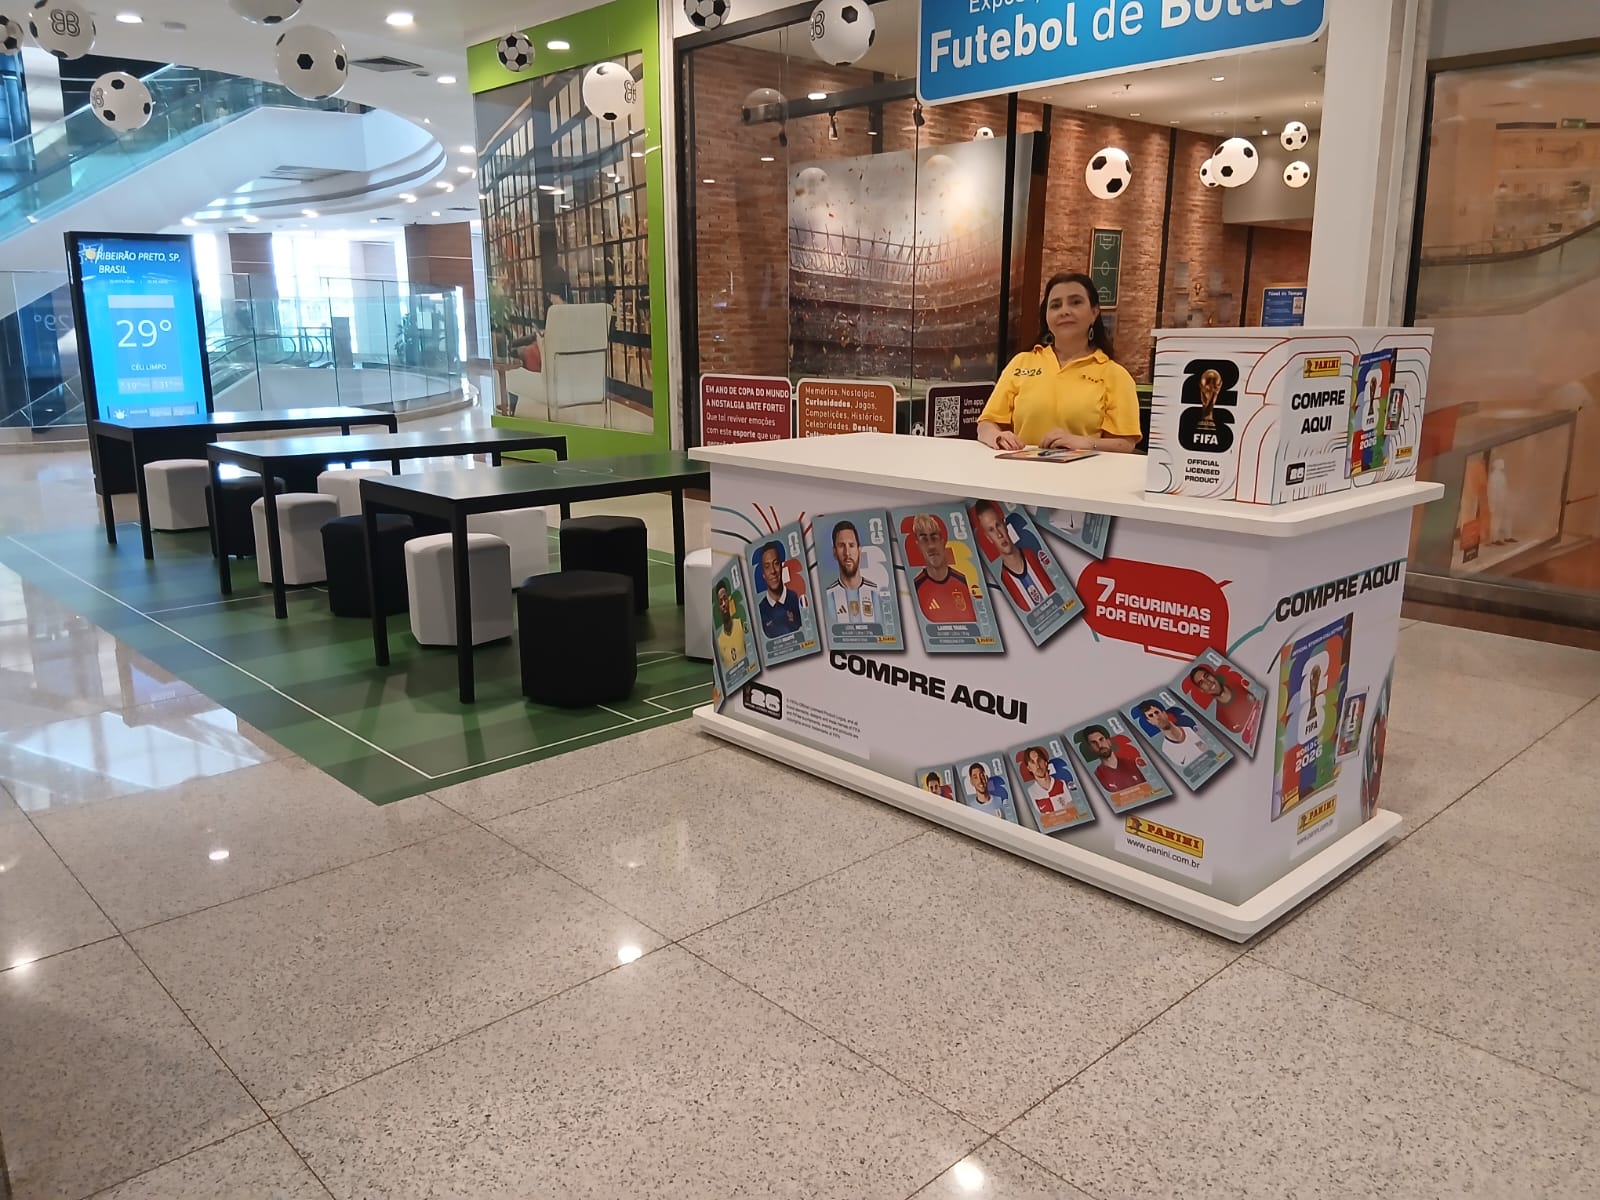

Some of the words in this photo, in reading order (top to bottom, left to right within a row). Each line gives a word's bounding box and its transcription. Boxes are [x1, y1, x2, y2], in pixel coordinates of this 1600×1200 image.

[930, 2, 1078, 72] Futebol
[1092, 0, 1144, 41] de
[97, 250, 137, 261] RIBEIRÃO
[98, 265, 127, 274] BRASIL
[116, 319, 172, 348] 29°
[1314, 359, 1339, 370] PANINI
[706, 385, 715, 393] EM
[716, 386, 728, 394] ANO
[729, 386, 738, 395] DE
[738, 387, 754, 396] COPA
[755, 388, 765, 397] DO
[766, 389, 789, 399] MUNDO
[1291, 389, 1346, 411] COMPRE
[711, 399, 745, 409] NOSTALGIA
[746, 401, 762, 411] BATE
[763, 403, 785, 413] FORTE!
[706, 412, 717, 421] Que
[718, 413, 726, 421] tal
[727, 415, 748, 423] reviver
[749, 417, 776, 427] emoções
[1301, 415, 1332, 435] AQUI
[707, 427, 719, 435] com
[720, 428, 732, 436] este
[733, 430, 756, 439] esporte
[757, 432, 769, 441] que
[1193, 433, 1219, 445] FIFA
[1187, 458, 1220, 467] OFFICIAL
[1184, 475, 1220, 484] PRODUCT
[1185, 467, 1221, 476] LICENSED
[1096, 576, 1116, 602] 7
[1115, 592, 1211, 622] FIGURINHAS
[1275, 574, 1359, 623] COMPRE
[1360, 561, 1401, 594] AQUI
[1096, 605, 1127, 622] POR
[1129, 611, 1210, 639] ENVELOPE
[829, 650, 946, 701] COMPRE
[951, 684, 1028, 724] AQUI
[1305, 721, 1318, 735] FIFA
[1295, 744, 1323, 773] 2026
[1309, 798, 1336, 821] PANINI
[1147, 823, 1200, 849] PANINI
[1126, 837, 1201, 870] www.panini.com.br
